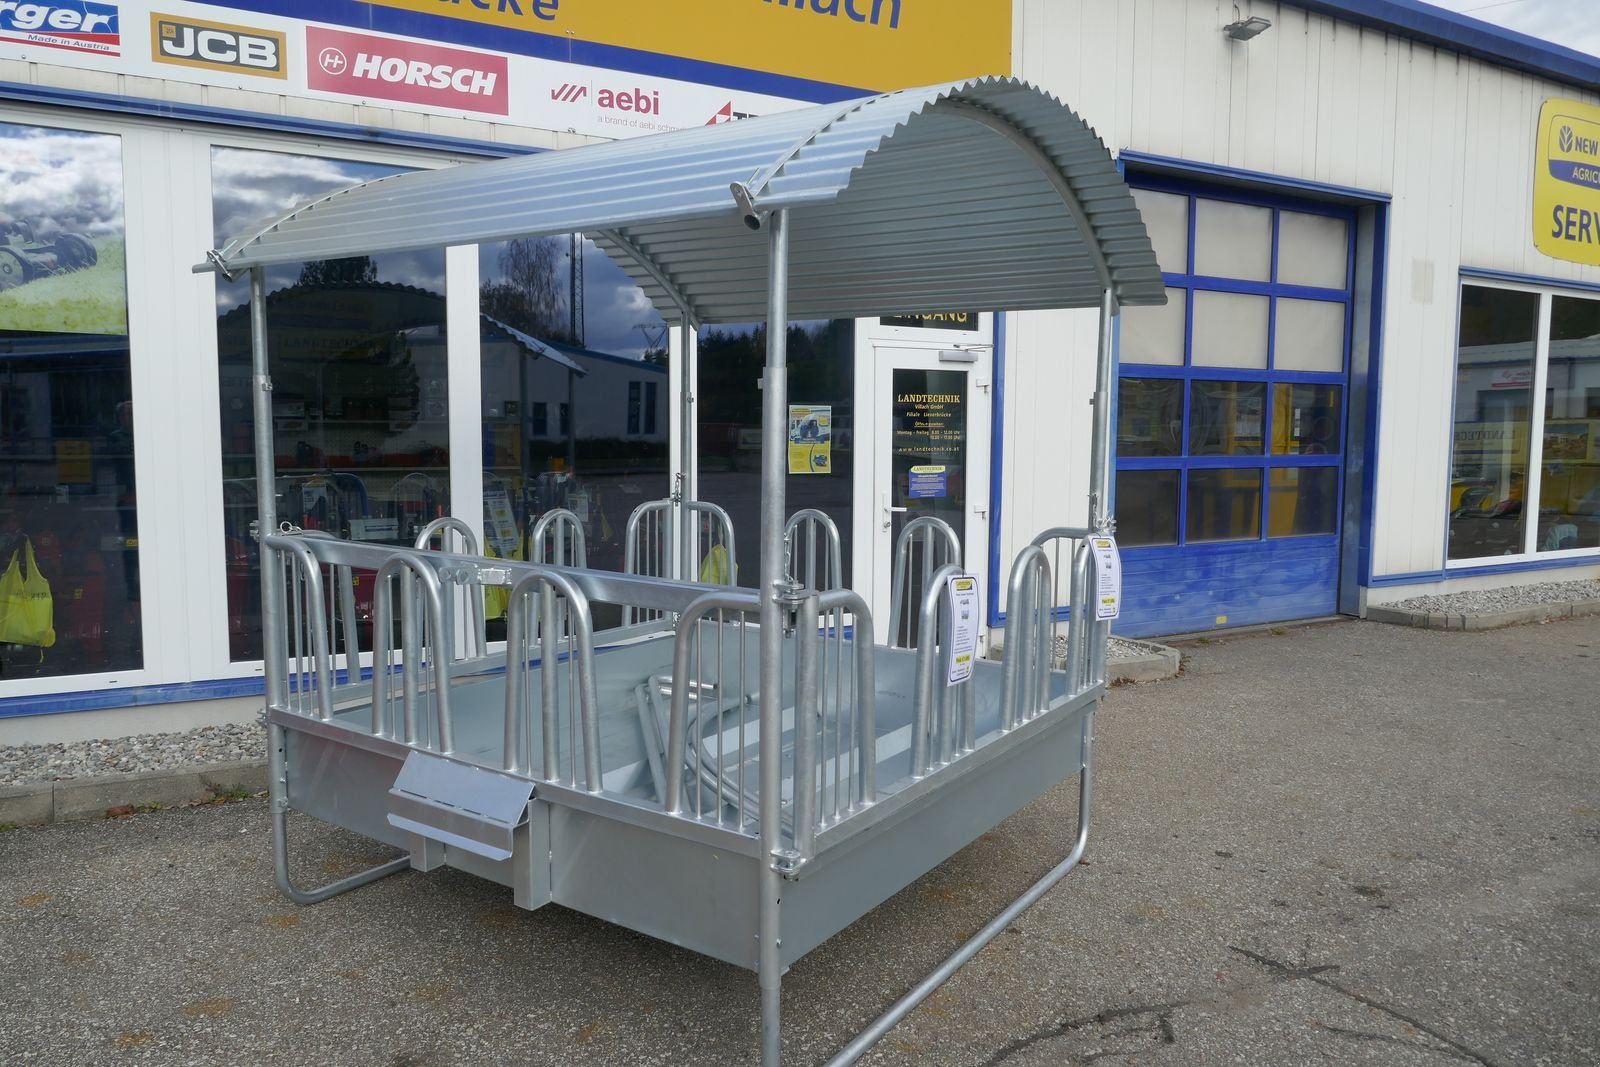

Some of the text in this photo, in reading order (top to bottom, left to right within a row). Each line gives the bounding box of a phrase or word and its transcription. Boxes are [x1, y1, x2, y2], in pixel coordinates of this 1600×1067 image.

[27, 34, 58, 43] Made
[73, 40, 110, 51] Austria
[162, 26, 278, 69] JCB
[352, 52, 497, 96] HORSCH
[597, 87, 659, 115] aebi
[605, 115, 628, 126] brand
[629, 120, 638, 128] of
[640, 121, 656, 130] aebi
[1575, 136, 1599, 156] NEW
[897, 394, 961, 403] LANDTECHNIK
